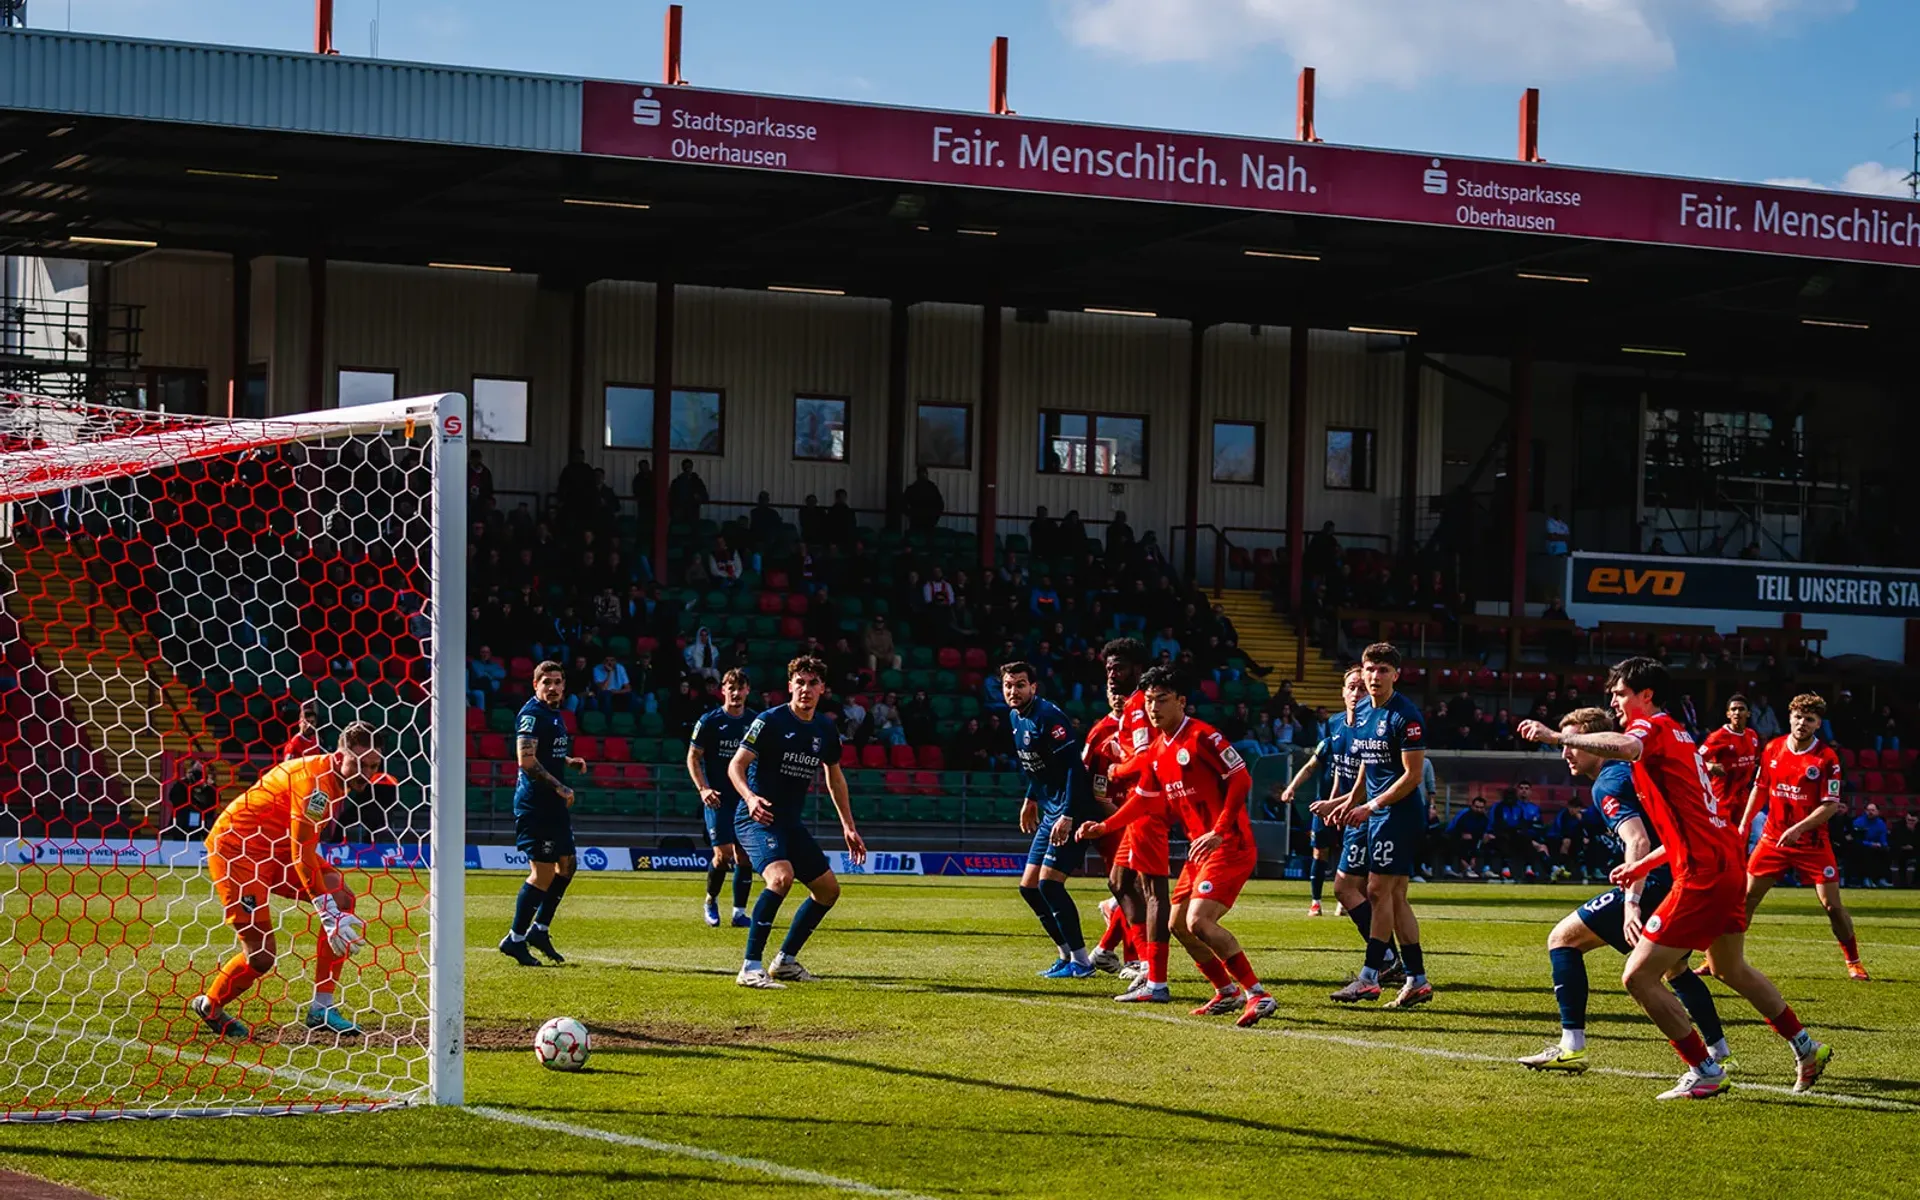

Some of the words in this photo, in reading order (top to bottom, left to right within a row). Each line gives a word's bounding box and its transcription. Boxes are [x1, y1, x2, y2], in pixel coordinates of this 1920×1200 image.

[671, 110, 817, 140] Stadtsparkasse
[671, 139, 787, 167] Oberhausen
[933, 127, 1005, 168] Fair.
[1019, 134, 1228, 188] Menschlich.
[1241, 153, 1318, 195] Nah.
[1456, 178, 1581, 208] Stadtsparkasse
[1456, 205, 1556, 232] Oberhausen
[1680, 193, 1741, 231] Fair.
[1588, 568, 1685, 596] evo
[1757, 575, 1793, 601] TEIL
[1799, 577, 1881, 605] UNSERER
[1887, 582, 1920, 607] STA
[652, 852, 708, 869] premio
[874, 852, 916, 871] ihb
[963, 855, 1019, 869] KESSEL
[1347, 843, 1367, 865] 31
[1372, 840, 1394, 862] 22
